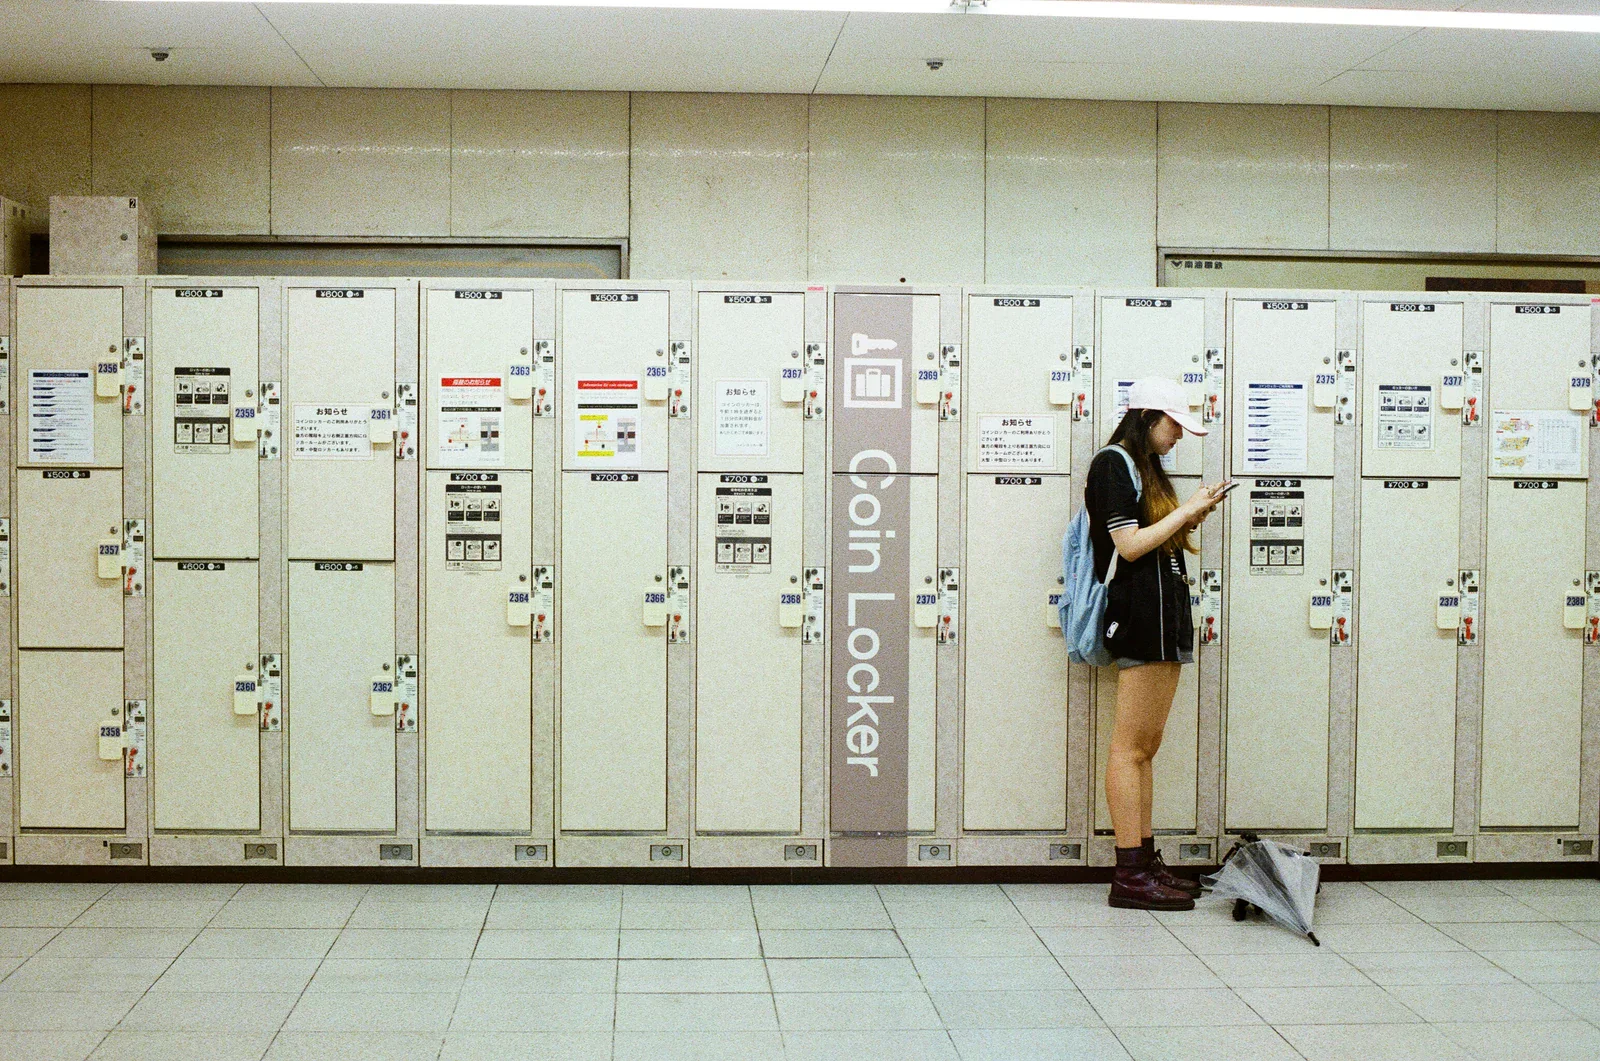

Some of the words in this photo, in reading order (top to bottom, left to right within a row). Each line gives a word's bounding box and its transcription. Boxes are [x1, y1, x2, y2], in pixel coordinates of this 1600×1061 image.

[130, 199, 136, 208] 2
[321, 290, 344, 298] ¥600
[596, 294, 618, 302] ¥500
[998, 299, 1021, 307] ¥500
[1130, 299, 1152, 307] ¥500
[1267, 302, 1289, 310] ¥500
[1395, 304, 1416, 312] ¥500
[98, 364, 118, 374] 2356
[510, 366, 530, 376] 2363
[646, 367, 666, 377] 2365
[782, 369, 802, 379] 2367
[918, 370, 938, 380] 2369
[1051, 371, 1071, 381] 2371
[1183, 373, 1203, 383] 2373
[1316, 374, 1335, 384] 2375
[1443, 376, 1463, 386] 2377
[1571, 378, 1591, 387] 2379
[726, 388, 756, 396] お知らせ
[235, 408, 255, 418] 2359
[316, 408, 348, 416] お知らせ
[371, 410, 391, 419] 2361
[1001, 419, 1032, 427] お知らせ
[47, 471, 70, 479] ¥500
[455, 473, 478, 481] ¥700
[725, 475, 748, 483] ¥700
[1000, 477, 1022, 485] ¥700
[1388, 481, 1410, 489] ¥700
[1518, 481, 1540, 489] ¥700
[848, 449, 897, 573] Coin
[100, 545, 119, 555] 2357
[509, 593, 529, 602] 2364
[645, 593, 665, 603] 2366
[781, 594, 801, 604] 2368
[916, 595, 936, 604] 2370
[1312, 596, 1331, 606] 2376
[1439, 597, 1459, 607] 2378
[1566, 596, 1585, 606] 2380
[236, 682, 256, 691] 2360
[373, 682, 392, 692] 2362
[846, 592, 896, 777] Locker
[100, 727, 121, 737] 2358
